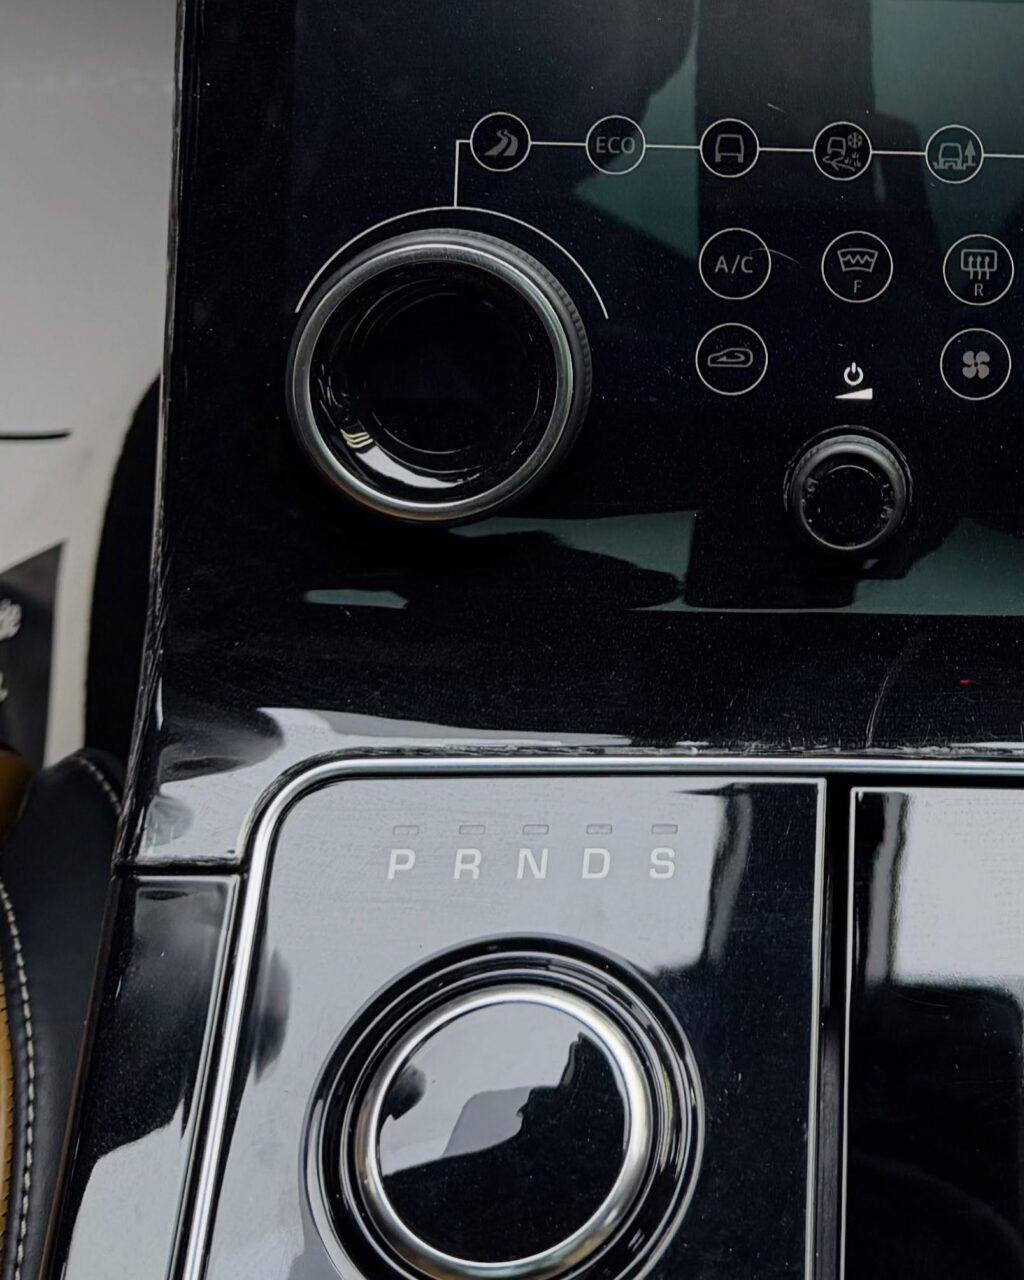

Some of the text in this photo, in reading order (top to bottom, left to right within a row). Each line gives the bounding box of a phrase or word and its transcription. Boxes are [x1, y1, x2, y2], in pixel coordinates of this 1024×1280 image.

[595, 136, 636, 156] ECO
[714, 255, 754, 274] A/C
[853, 280, 863, 293] F
[974, 283, 984, 296] R
[387, 848, 675, 880] P R N D S
